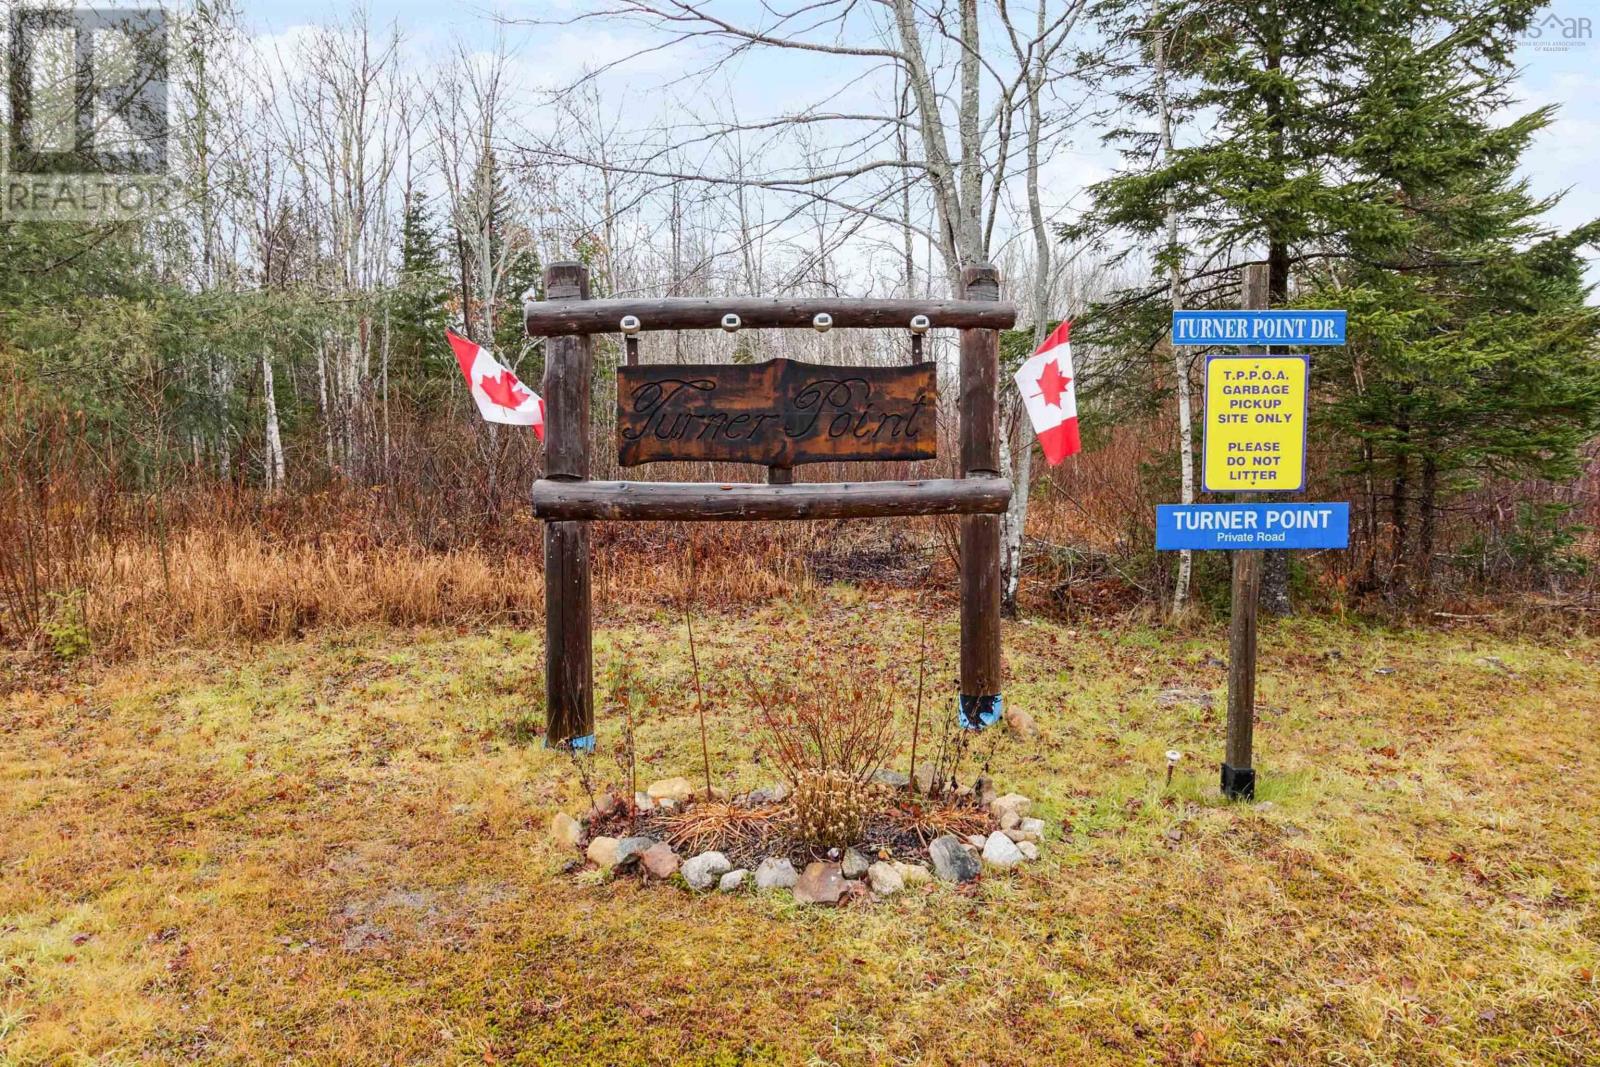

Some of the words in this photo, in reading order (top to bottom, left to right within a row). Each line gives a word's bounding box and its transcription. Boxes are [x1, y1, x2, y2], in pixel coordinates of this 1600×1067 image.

[1177, 318, 1249, 339] TURNER
[1253, 318, 1307, 339] POINT
[1310, 318, 1339, 339] DR.
[1223, 370, 1289, 381] T.P.P.O.A.
[1222, 385, 1290, 395] GARBAGE
[622, 378, 780, 440] Turner
[783, 377, 928, 439] Point
[1229, 399, 1282, 409] PICKUP
[1218, 414, 1248, 424] SITE
[1254, 413, 1293, 423] ONLY
[1228, 442, 1281, 452] PLEASE
[1226, 456, 1246, 466] DO
[1252, 456, 1281, 466] NOT
[1229, 470, 1277, 480] LITTER
[1173, 511, 1258, 530] TURNER
[1266, 510, 1333, 529] POINT
[1217, 532, 1254, 542] Private
[1257, 532, 1285, 542] Road
